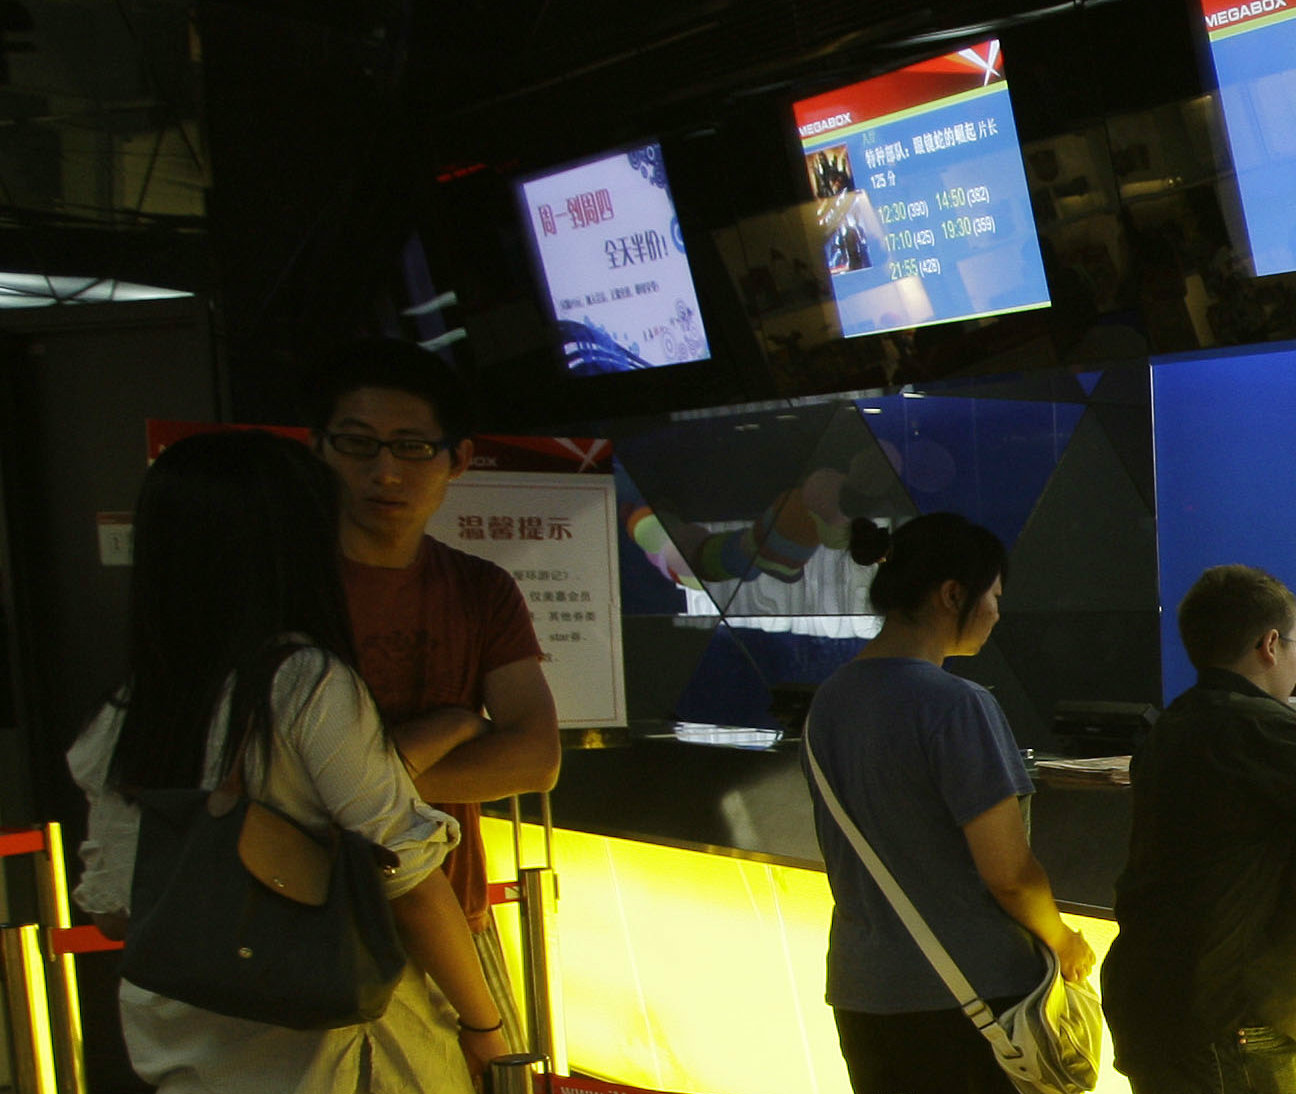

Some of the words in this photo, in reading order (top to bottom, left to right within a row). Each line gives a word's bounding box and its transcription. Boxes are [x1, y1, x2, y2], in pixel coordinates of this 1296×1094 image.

[798, 112, 853, 136] MEGABOX
[870, 172, 887, 189] 125
[887, 170, 896, 187] 分
[538, 188, 614, 237] 周一到周四
[878, 201, 907, 225] 12:30
[936, 187, 966, 211] 14:50
[885, 230, 913, 252] 17:10
[913, 229, 935, 250] (425)
[941, 216, 972, 239] 19:30
[889, 258, 918, 281] 21:55
[458, 515, 573, 541] 温馨提示
